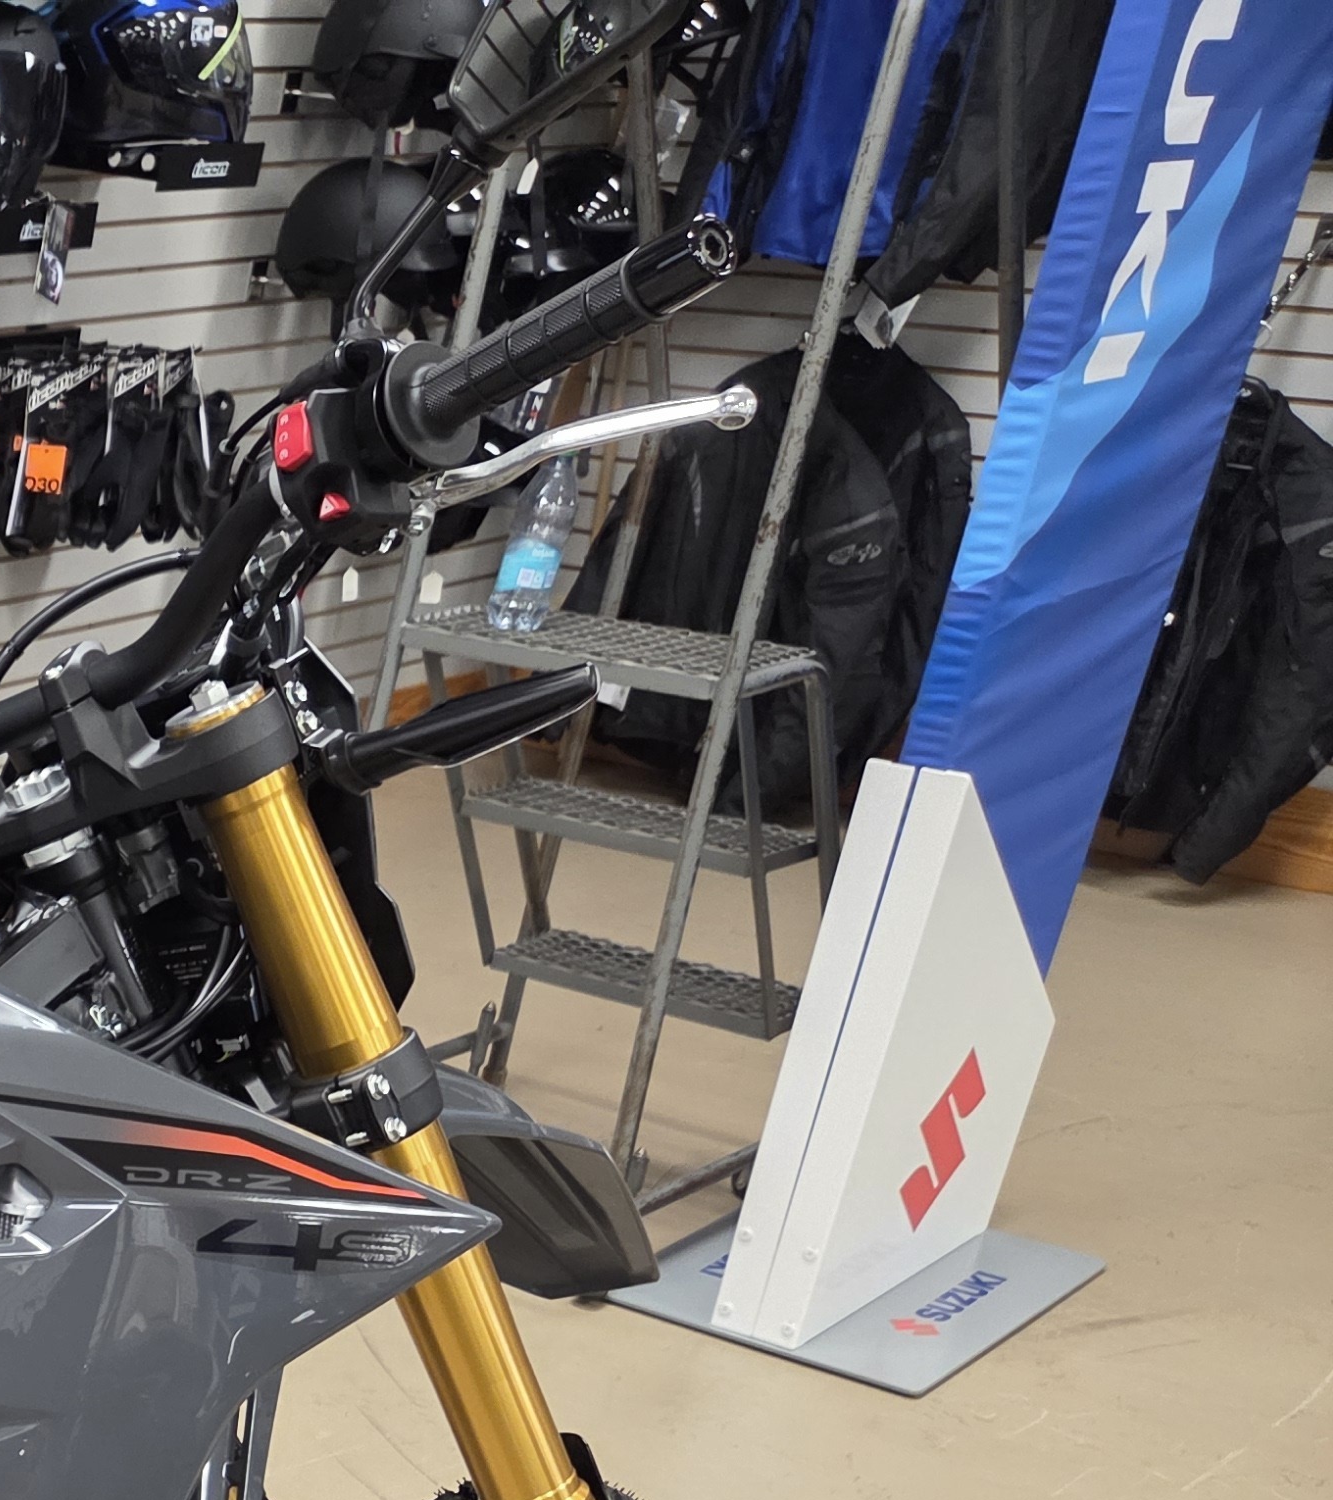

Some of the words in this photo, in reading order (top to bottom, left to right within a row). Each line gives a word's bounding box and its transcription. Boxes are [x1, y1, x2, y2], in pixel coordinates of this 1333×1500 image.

[192, 157, 230, 179] icon
[122, 1165, 293, 1193] DR-Z
[914, 1270, 1008, 1323] SUZUKI
